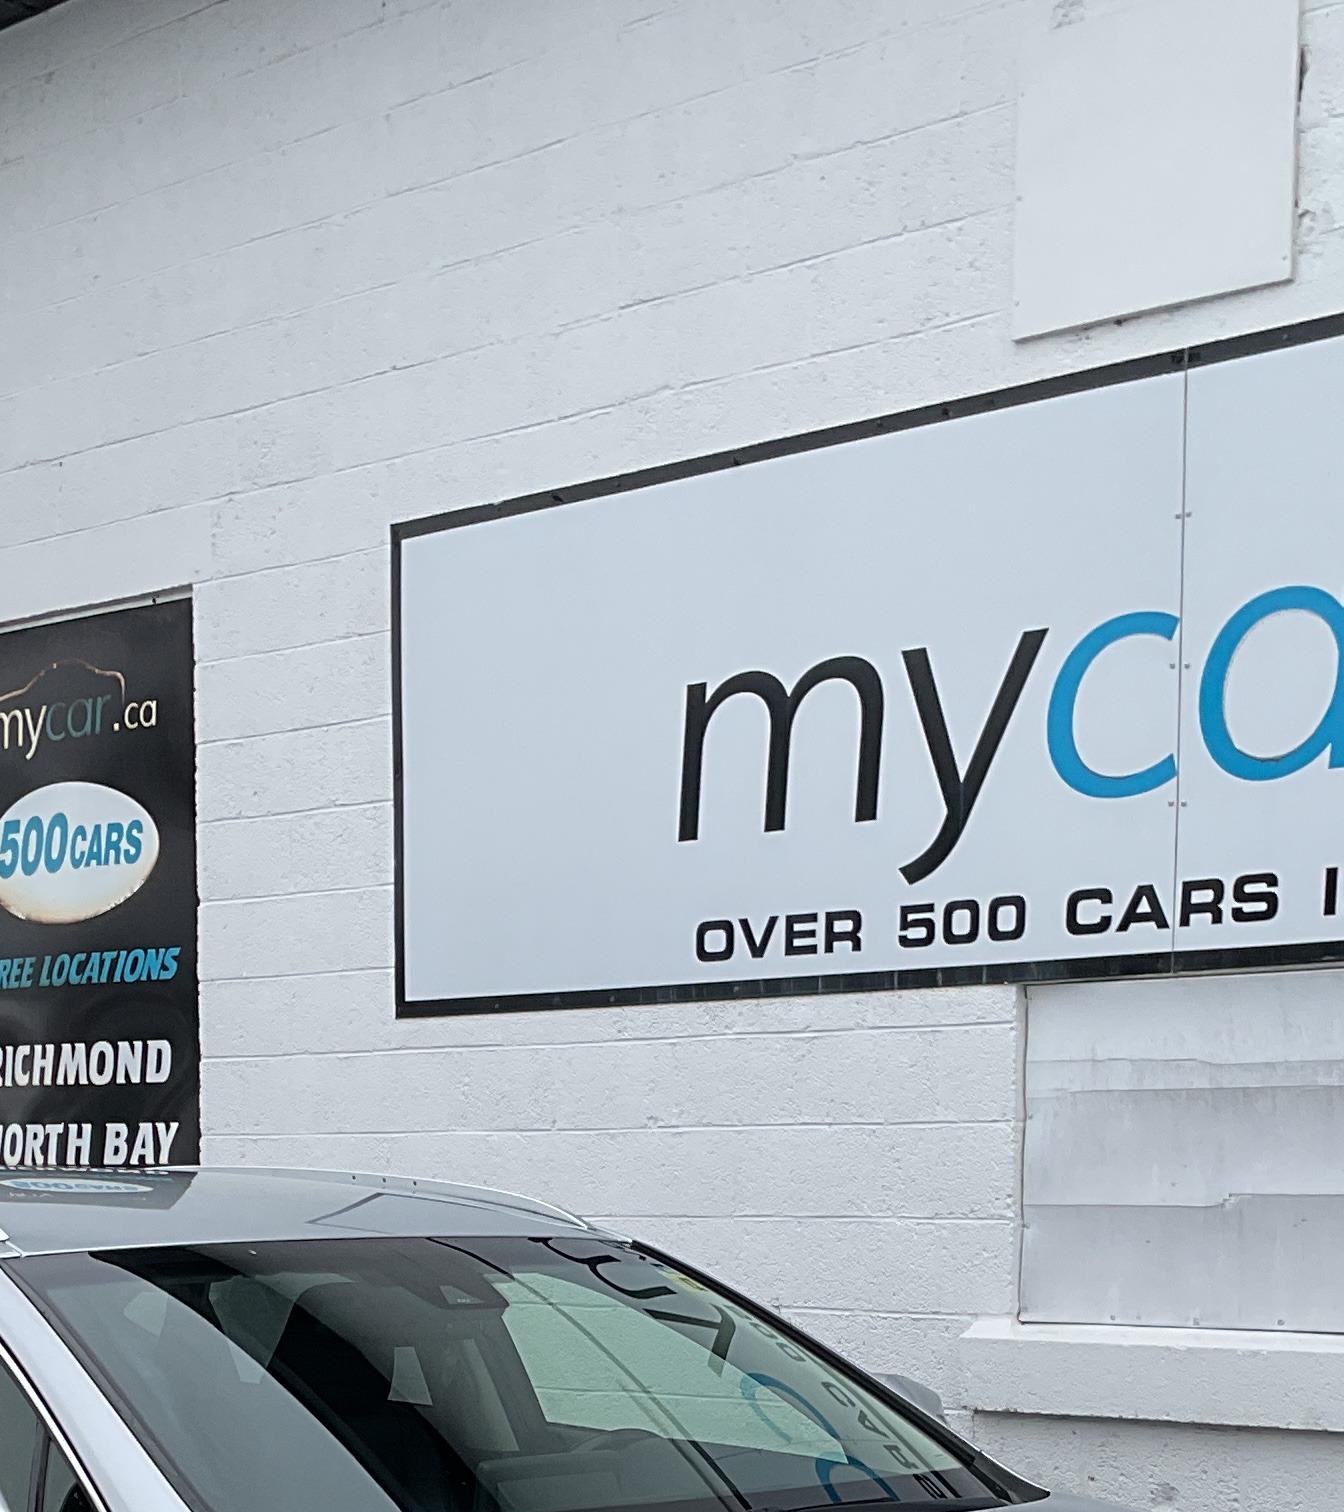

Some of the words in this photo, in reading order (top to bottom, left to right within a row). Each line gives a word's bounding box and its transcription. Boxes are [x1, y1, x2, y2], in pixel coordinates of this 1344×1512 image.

[695, 909, 863, 963] OVER
[897, 895, 1027, 949] 500
[1065, 872, 1279, 936] CARS
[38, 946, 182, 988] LOCATIONS
[103, 1121, 180, 1166] BAY
